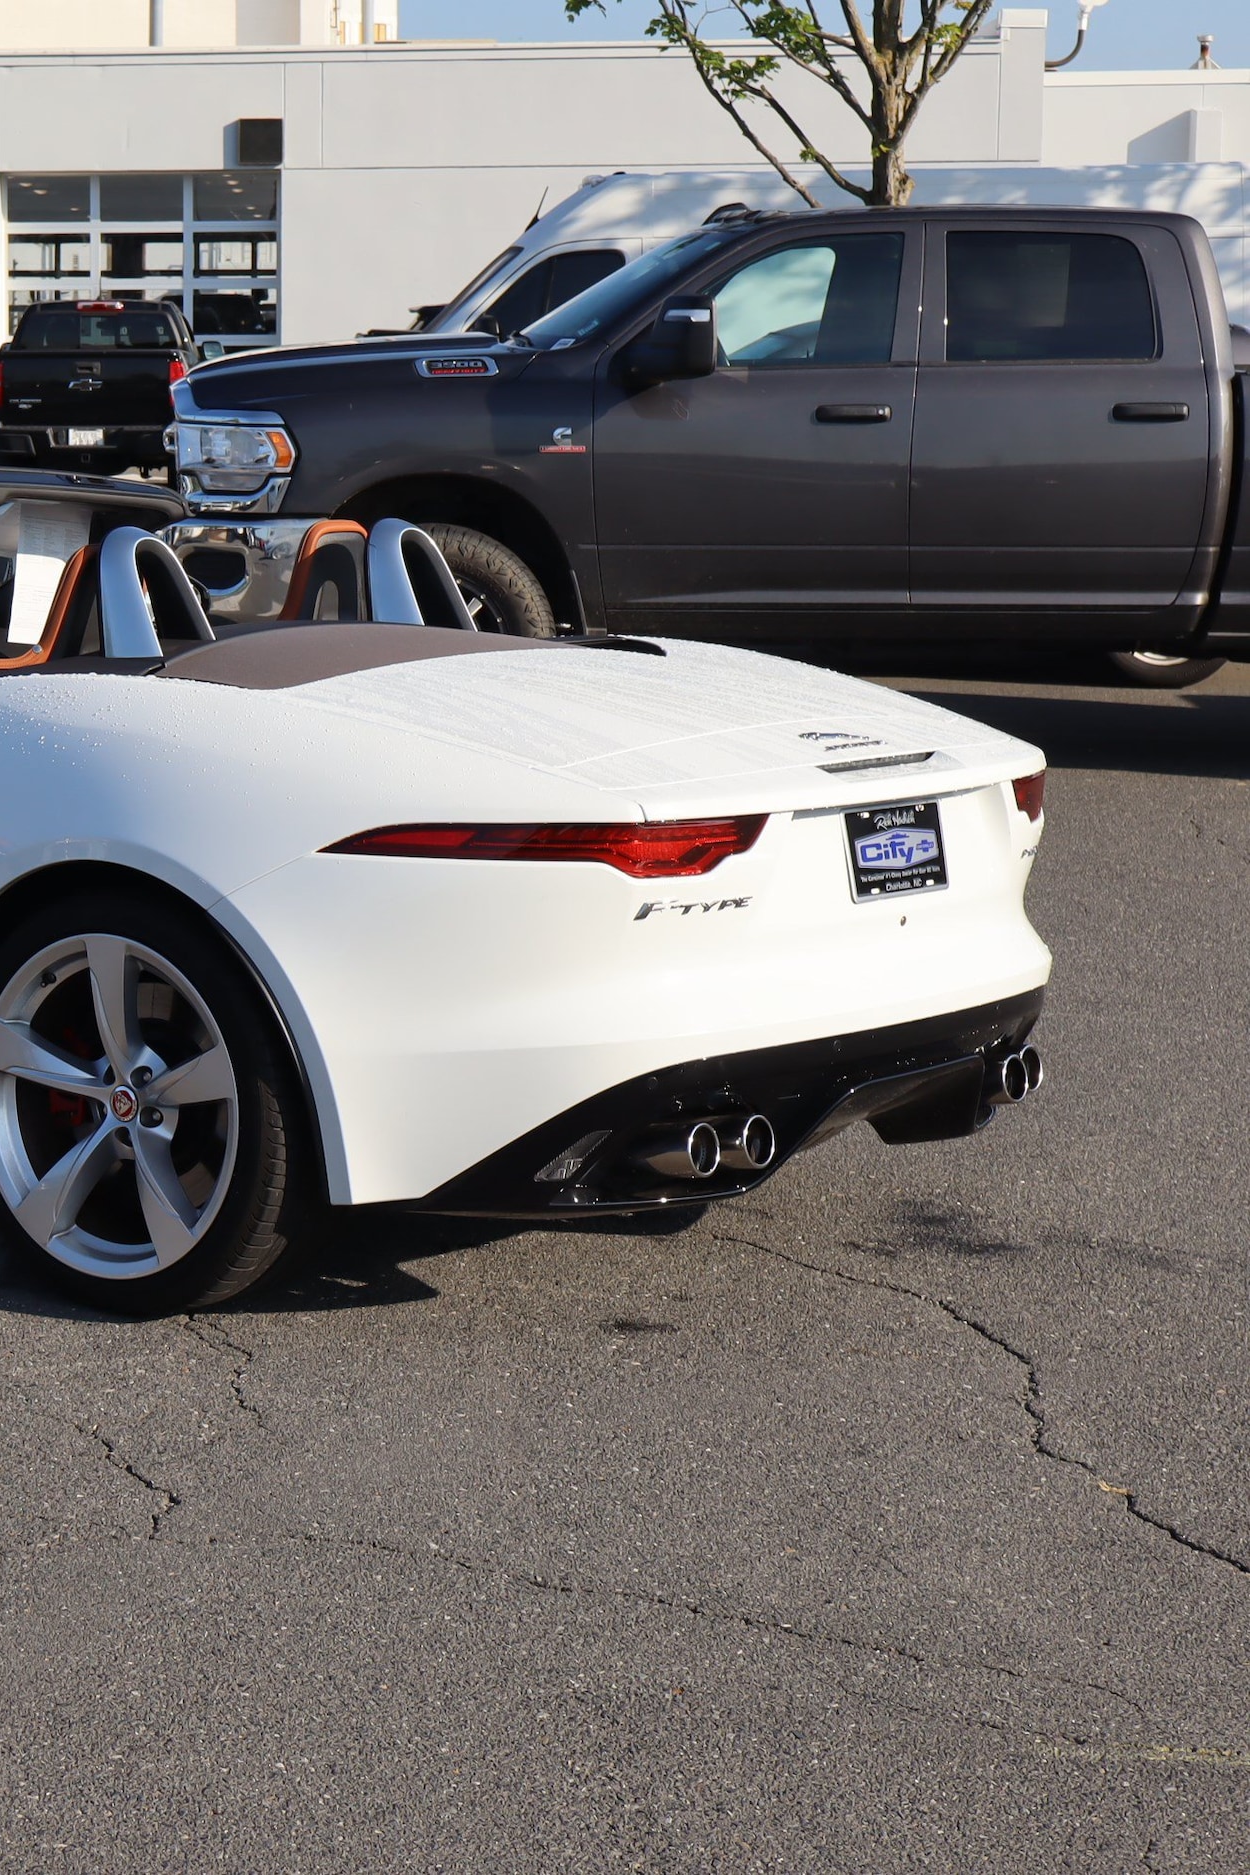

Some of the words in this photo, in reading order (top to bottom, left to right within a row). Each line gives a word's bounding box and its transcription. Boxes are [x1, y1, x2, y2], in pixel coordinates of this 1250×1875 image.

[860, 841, 914, 864] City
[913, 877, 924, 888] NC
[632, 896, 754, 921] F-TYPE
